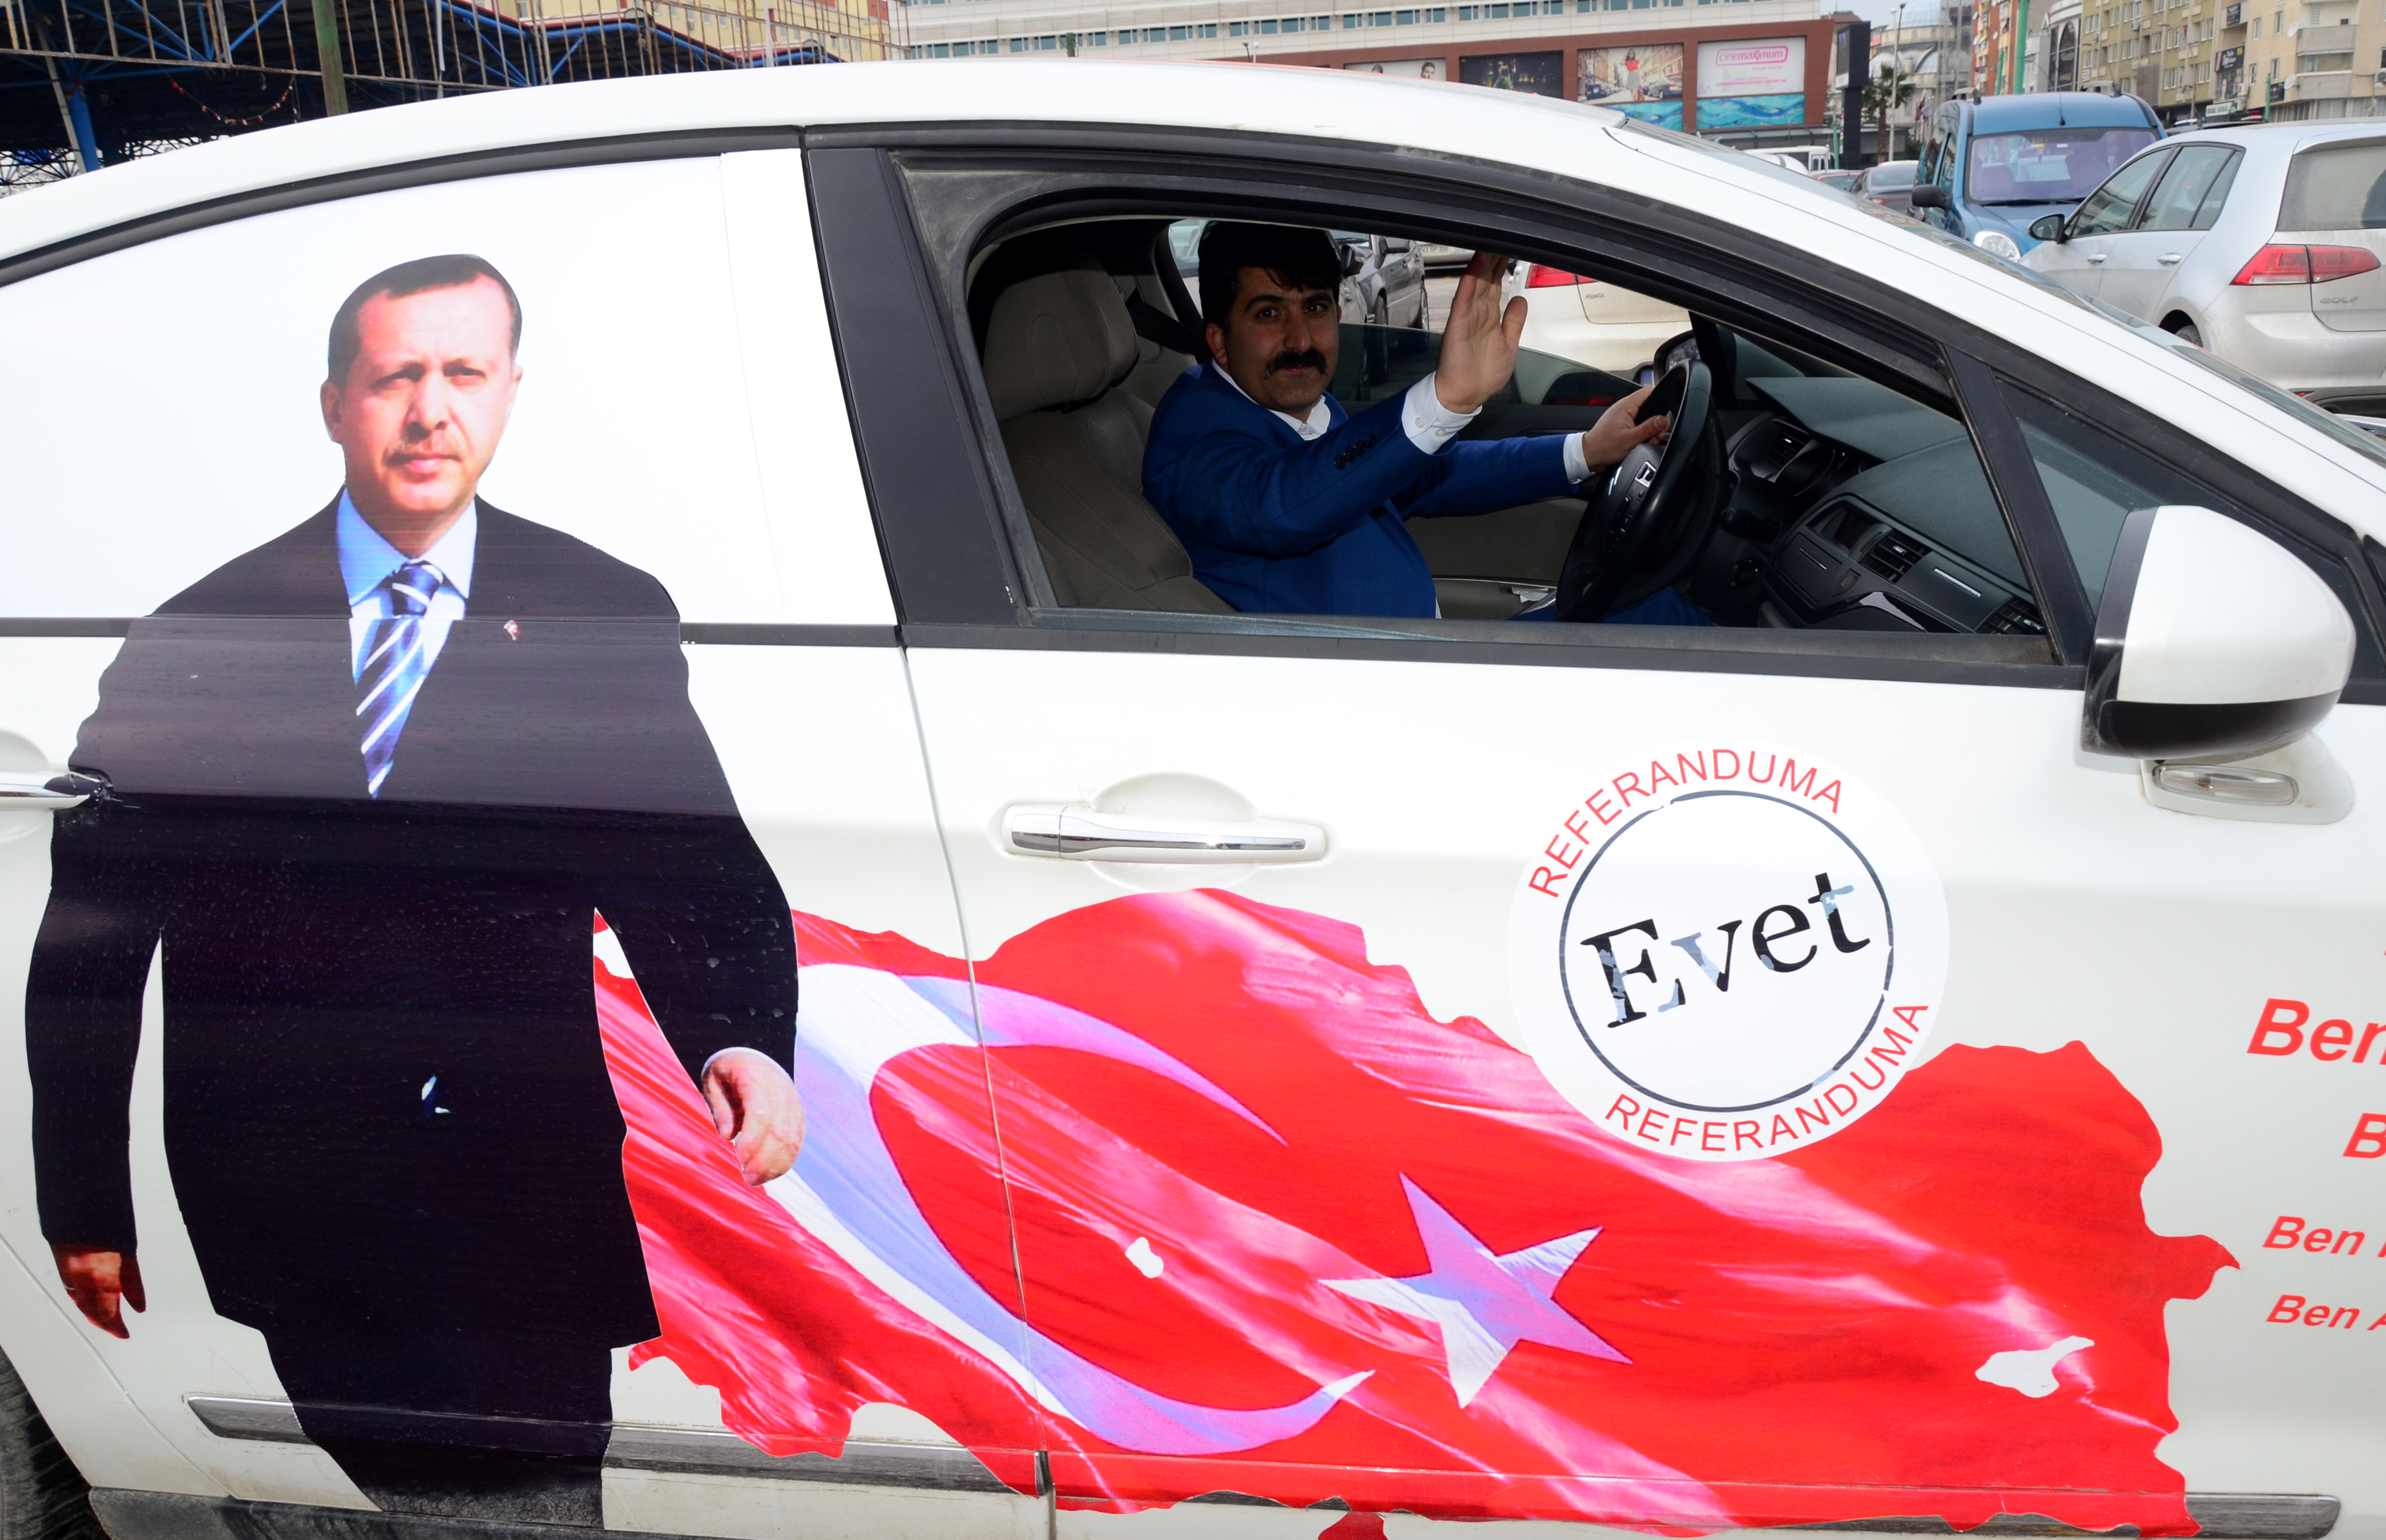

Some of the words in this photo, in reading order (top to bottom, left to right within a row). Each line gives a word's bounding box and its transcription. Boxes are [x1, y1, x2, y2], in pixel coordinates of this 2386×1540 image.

[1719, 49, 1784, 61] cinemaximum
[1528, 749, 1842, 898] REFERANDUMA
[1580, 872, 1871, 1029] Evet
[1605, 1005, 1930, 1152] REFERANDUMA
[2262, 1215, 2366, 1256] Ben
[2266, 1294, 2361, 1330] Ben
